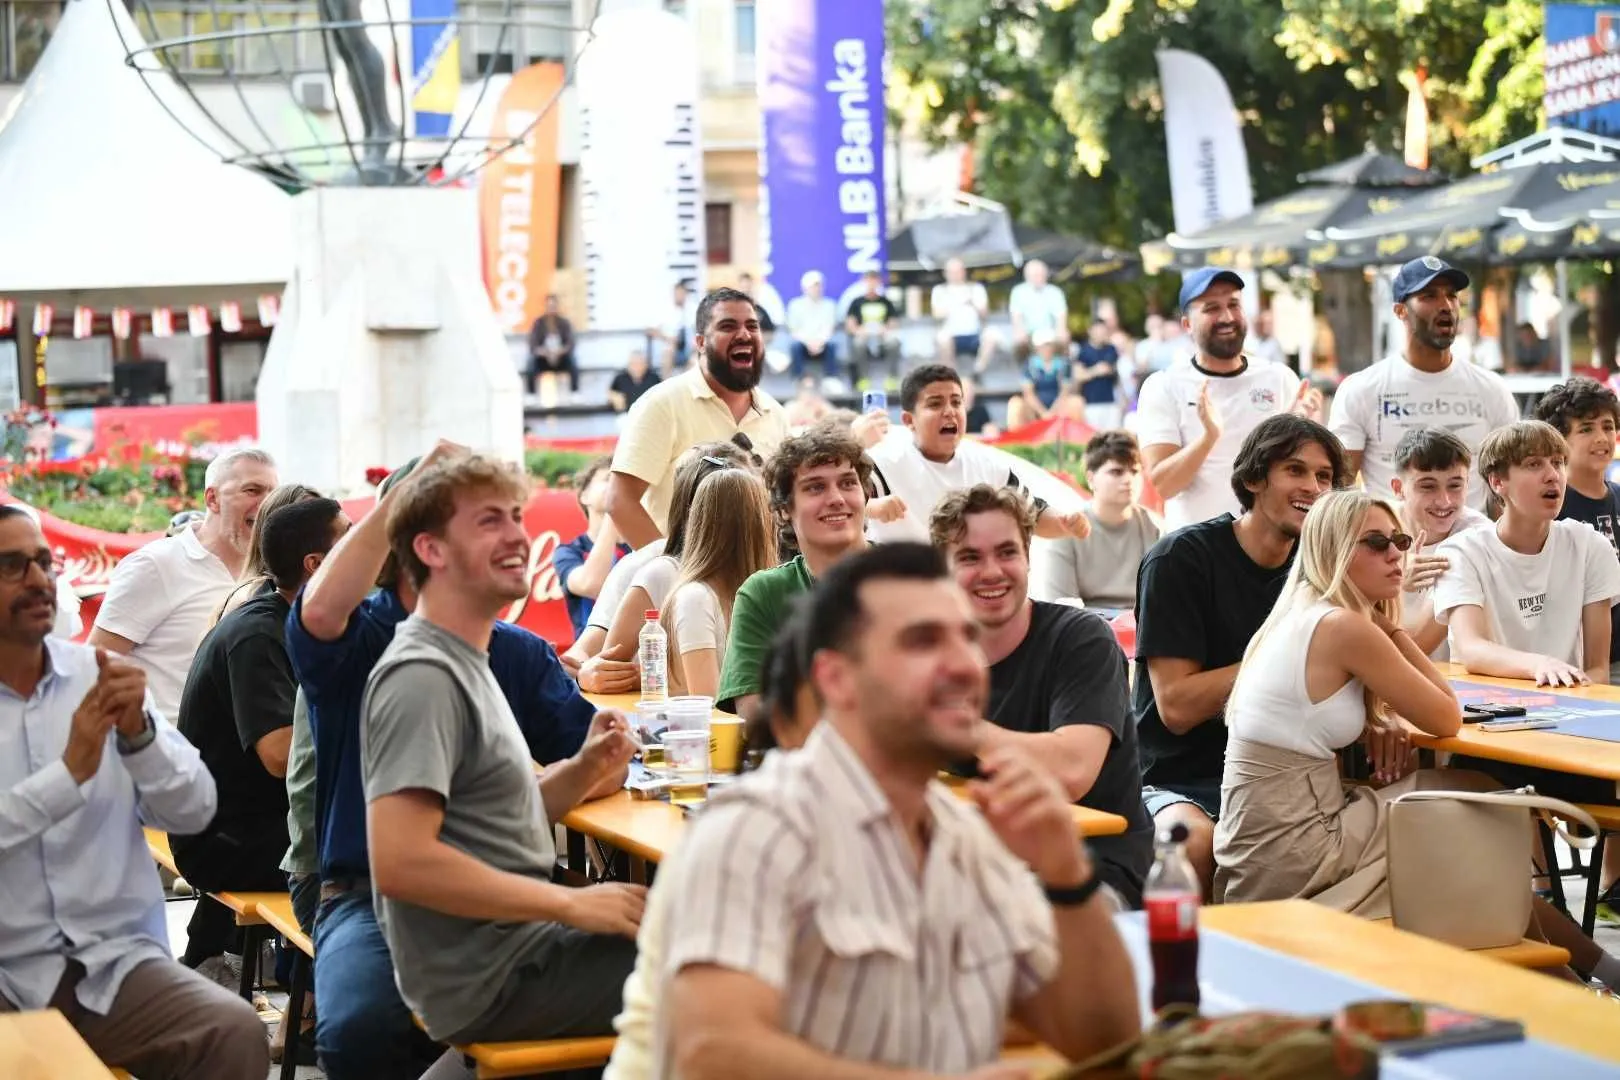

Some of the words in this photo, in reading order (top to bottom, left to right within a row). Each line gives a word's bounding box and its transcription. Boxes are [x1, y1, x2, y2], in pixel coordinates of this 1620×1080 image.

[825, 38, 875, 175] Banka
[839, 178, 882, 274] NLB
[1518, 596, 1534, 611] NEW
